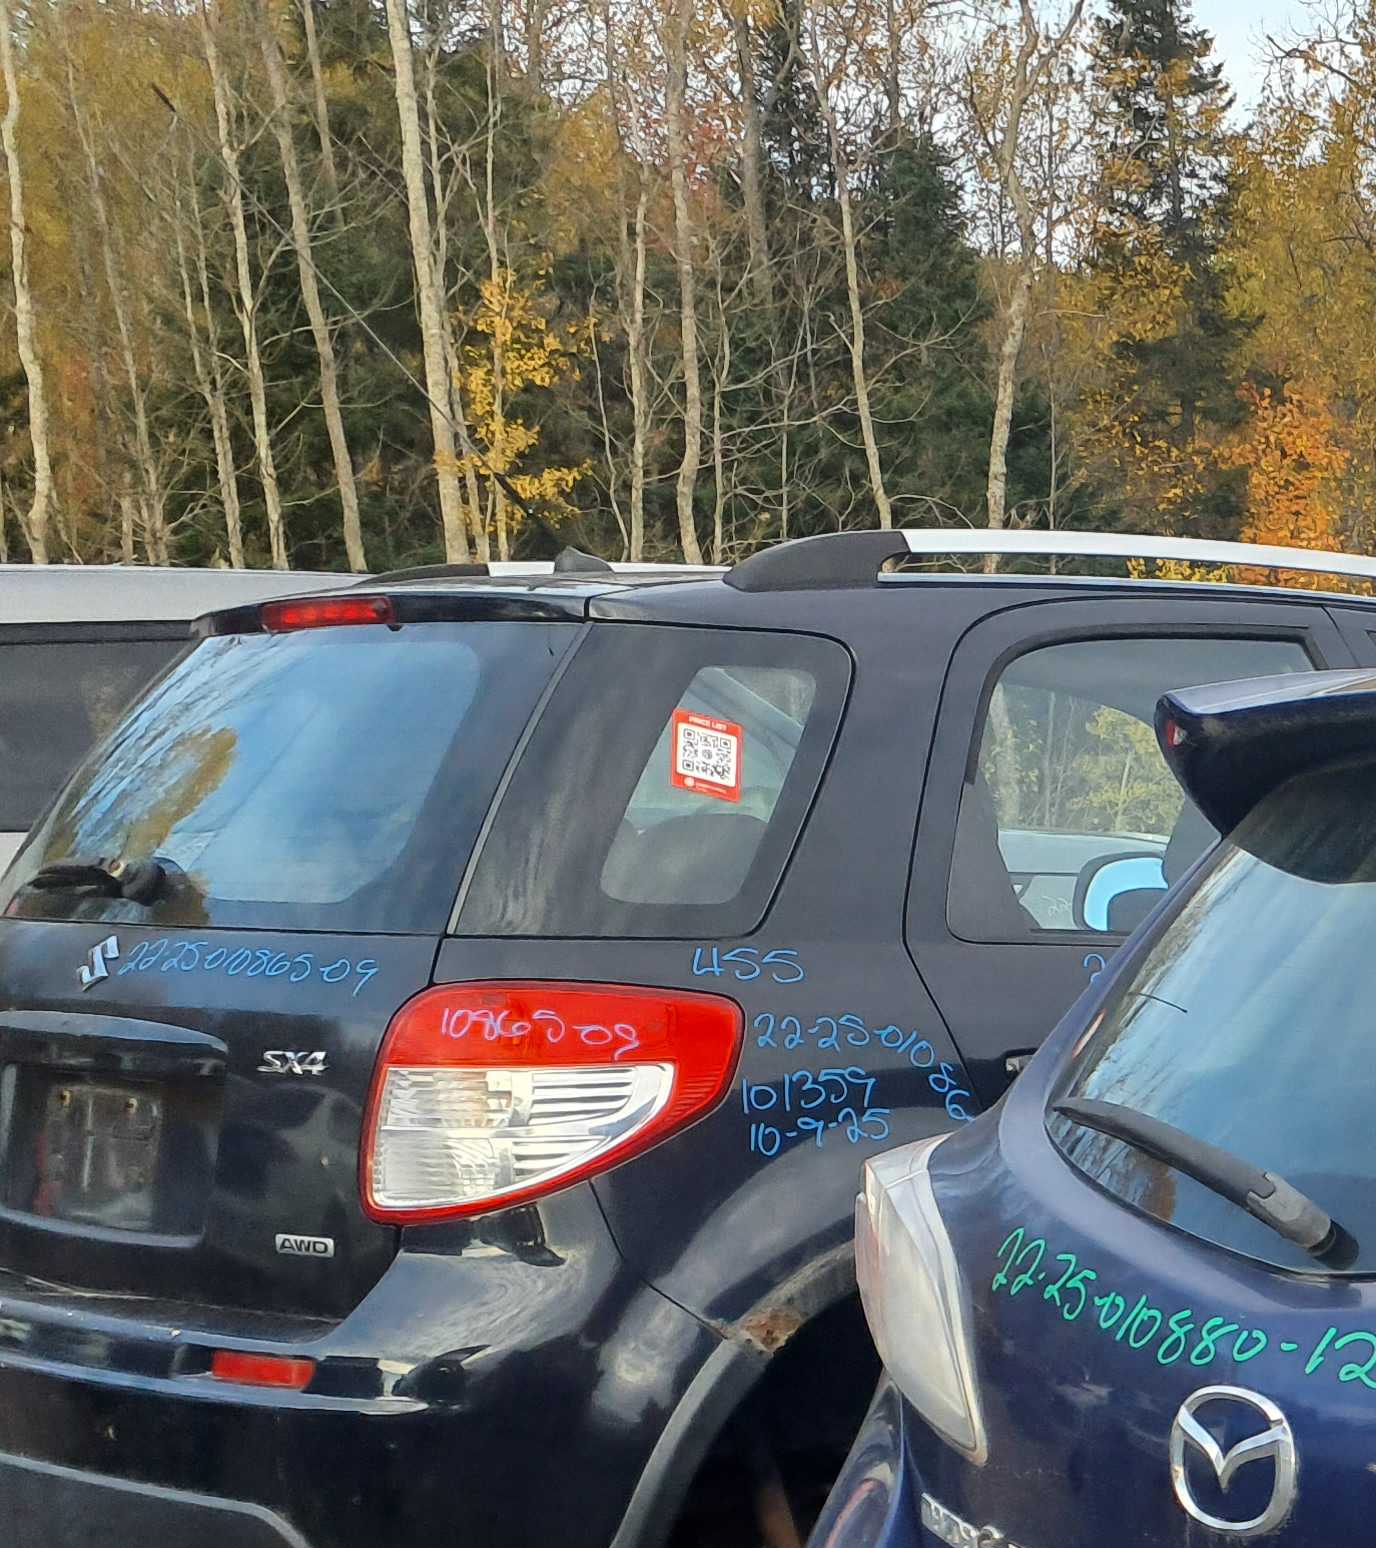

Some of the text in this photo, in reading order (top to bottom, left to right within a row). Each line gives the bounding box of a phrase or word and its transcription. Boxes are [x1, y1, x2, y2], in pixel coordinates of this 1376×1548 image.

[693, 947, 804, 983] 455
[256, 1050, 328, 1075] SX4
[280, 1238, 328, 1254] AWD
